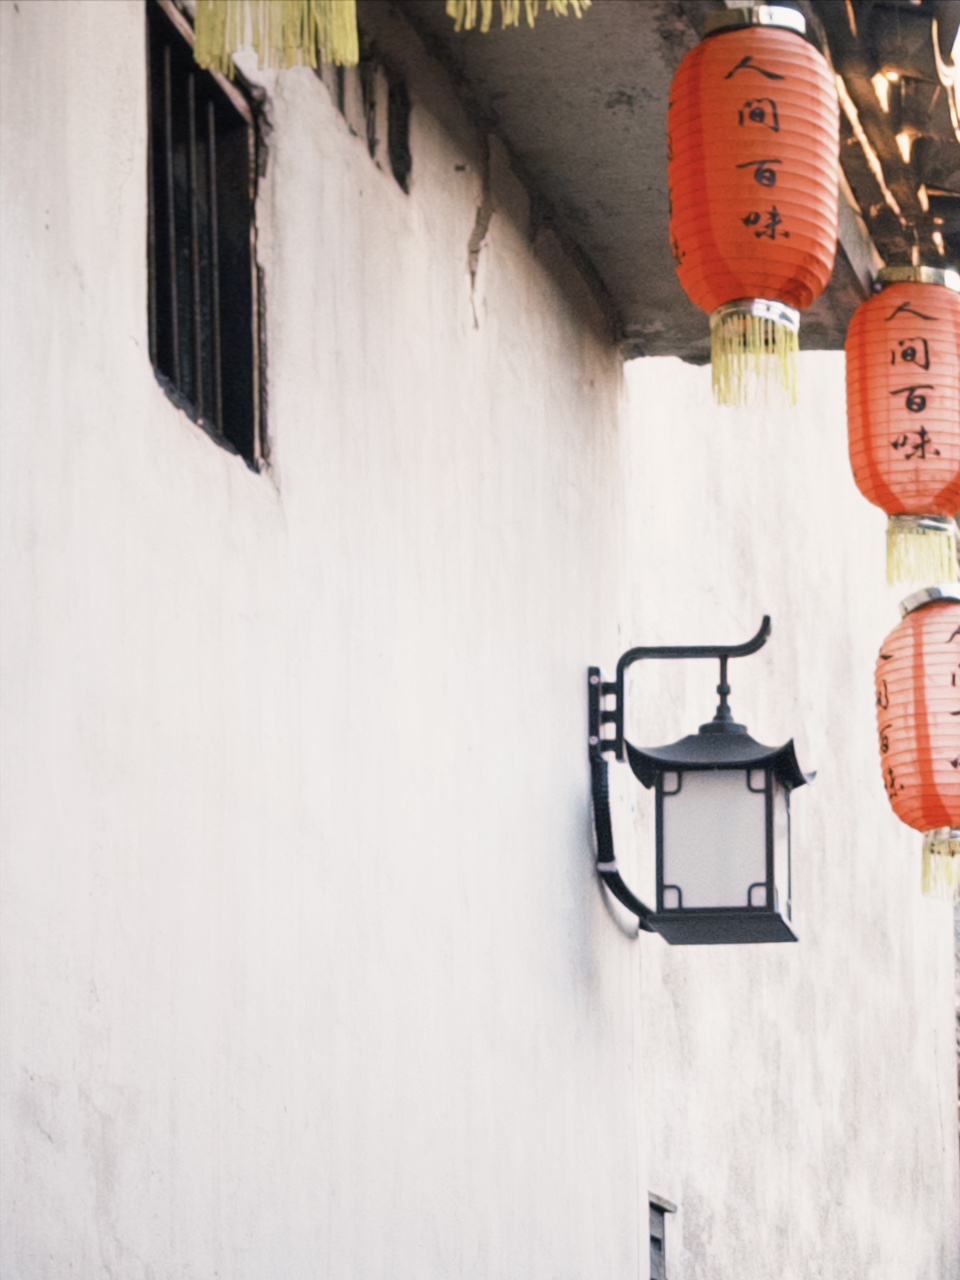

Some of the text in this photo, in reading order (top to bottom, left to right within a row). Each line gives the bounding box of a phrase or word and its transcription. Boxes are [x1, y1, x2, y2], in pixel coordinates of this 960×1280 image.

[724, 55, 791, 241] 人间百味
[885, 301, 941, 460] 人间百味
